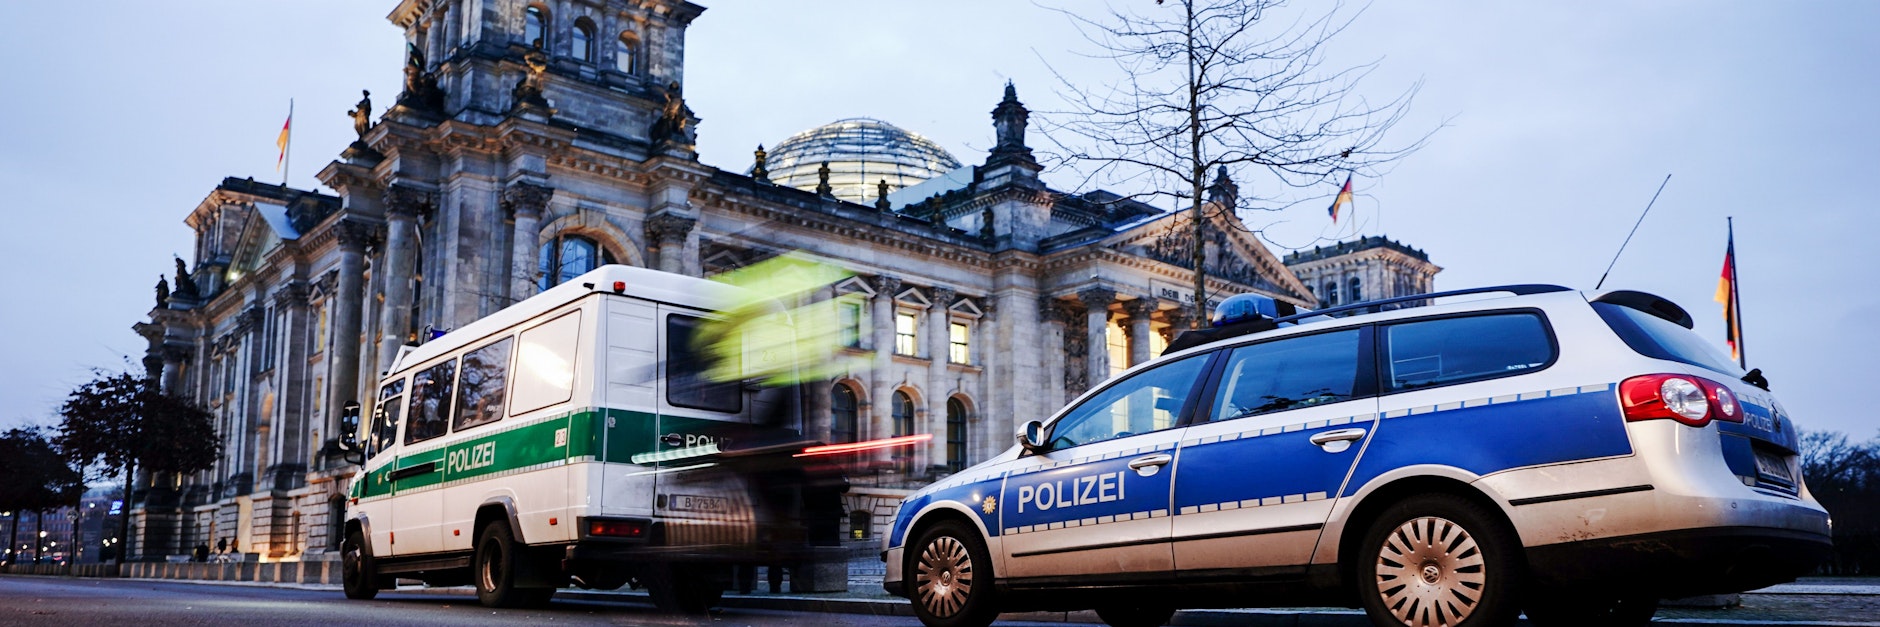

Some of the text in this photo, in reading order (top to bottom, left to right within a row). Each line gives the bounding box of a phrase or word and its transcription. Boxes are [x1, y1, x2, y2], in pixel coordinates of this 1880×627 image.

[1161, 287, 1180, 300] DEM
[556, 430, 566, 445] 23
[447, 440, 497, 475] POLIZEI
[1017, 470, 1126, 514] POLIZEI
[685, 497, 692, 508] B
